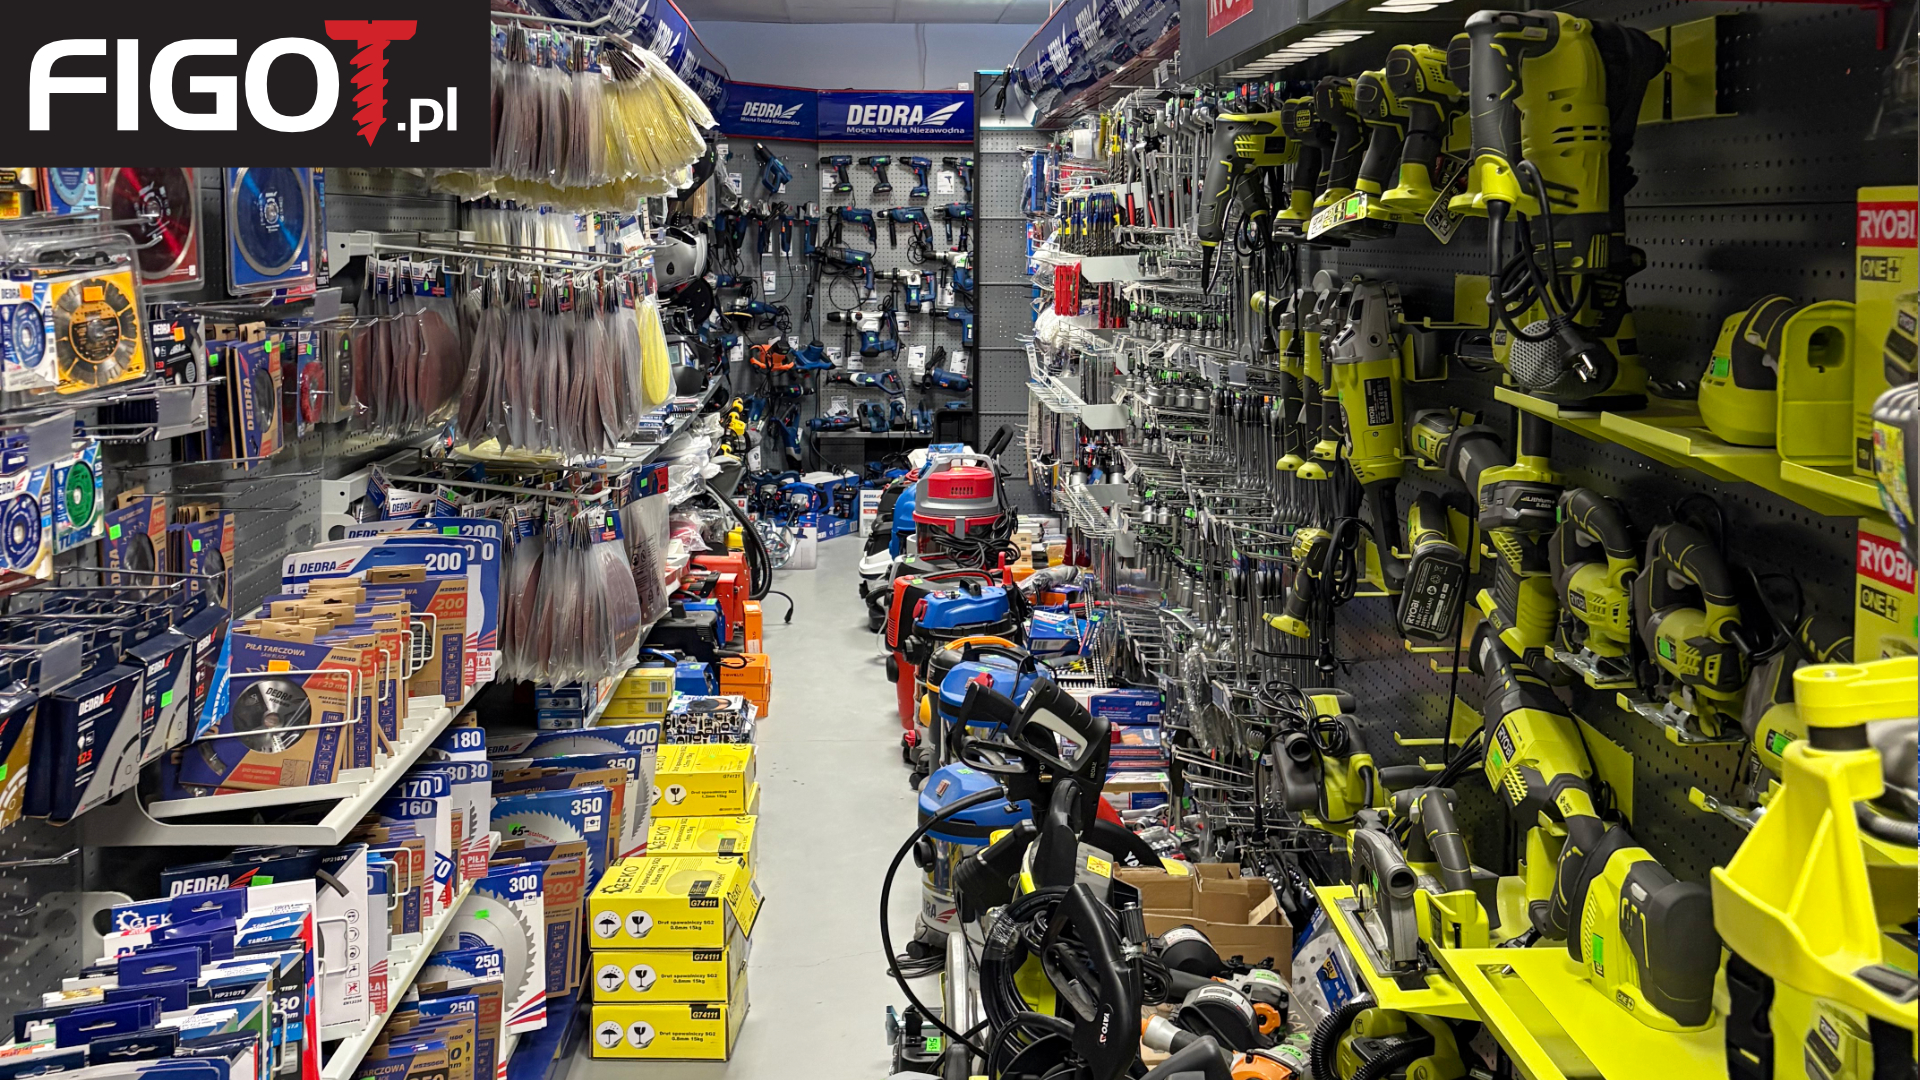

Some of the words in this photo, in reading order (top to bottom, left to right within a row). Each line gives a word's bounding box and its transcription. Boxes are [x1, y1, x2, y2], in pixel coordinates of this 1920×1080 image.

[741, 101, 783, 118] DEDRA
[846, 104, 923, 126] DEDRA
[846, 126, 877, 134] Mocna
[878, 126, 908, 134] Trwała
[909, 126, 965, 134] Niezawodna
[1859, 209, 1916, 240] RYOBI
[153, 323, 170, 335] DEDRA
[243, 378, 254, 431] DEDRA
[392, 502, 412, 512] DEDRA
[462, 524, 496, 537] 200
[300, 561, 336, 573] DEDRA
[425, 553, 461, 571] 200
[1859, 539, 1914, 585] RYOBI
[435, 597, 464, 610] 200
[1406, 600, 1420, 624] RYOBI
[245, 643, 263, 651] PIŁA
[264, 645, 306, 657] TARCZOWA
[147, 659, 165, 677] DEDRA
[266, 688, 292, 701] DEDRA
[78, 693, 105, 716] DEDRA
[451, 731, 480, 748] 180
[624, 729, 657, 745] 400
[1498, 726, 1514, 759] RYOBI
[77, 749, 92, 766] 125
[487, 745, 509, 754] EDRA
[607, 758, 635, 772] 350
[399, 780, 431, 797] 170
[399, 800, 432, 816] 160
[571, 797, 603, 815] 350
[467, 855, 485, 864] PIŁA
[170, 874, 230, 897] DEDRA
[509, 875, 537, 893] 300
[614, 865, 640, 890] GEKO
[691, 899, 717, 907] G74111
[130, 913, 172, 927] GEK
[248, 935, 273, 944] TARCZA
[475, 954, 499, 969] 250
[694, 953, 720, 961] G74111
[214, 989, 245, 999] HP2107E
[450, 1000, 475, 1014] 250
[1101, 1012, 1111, 1035] YATO
